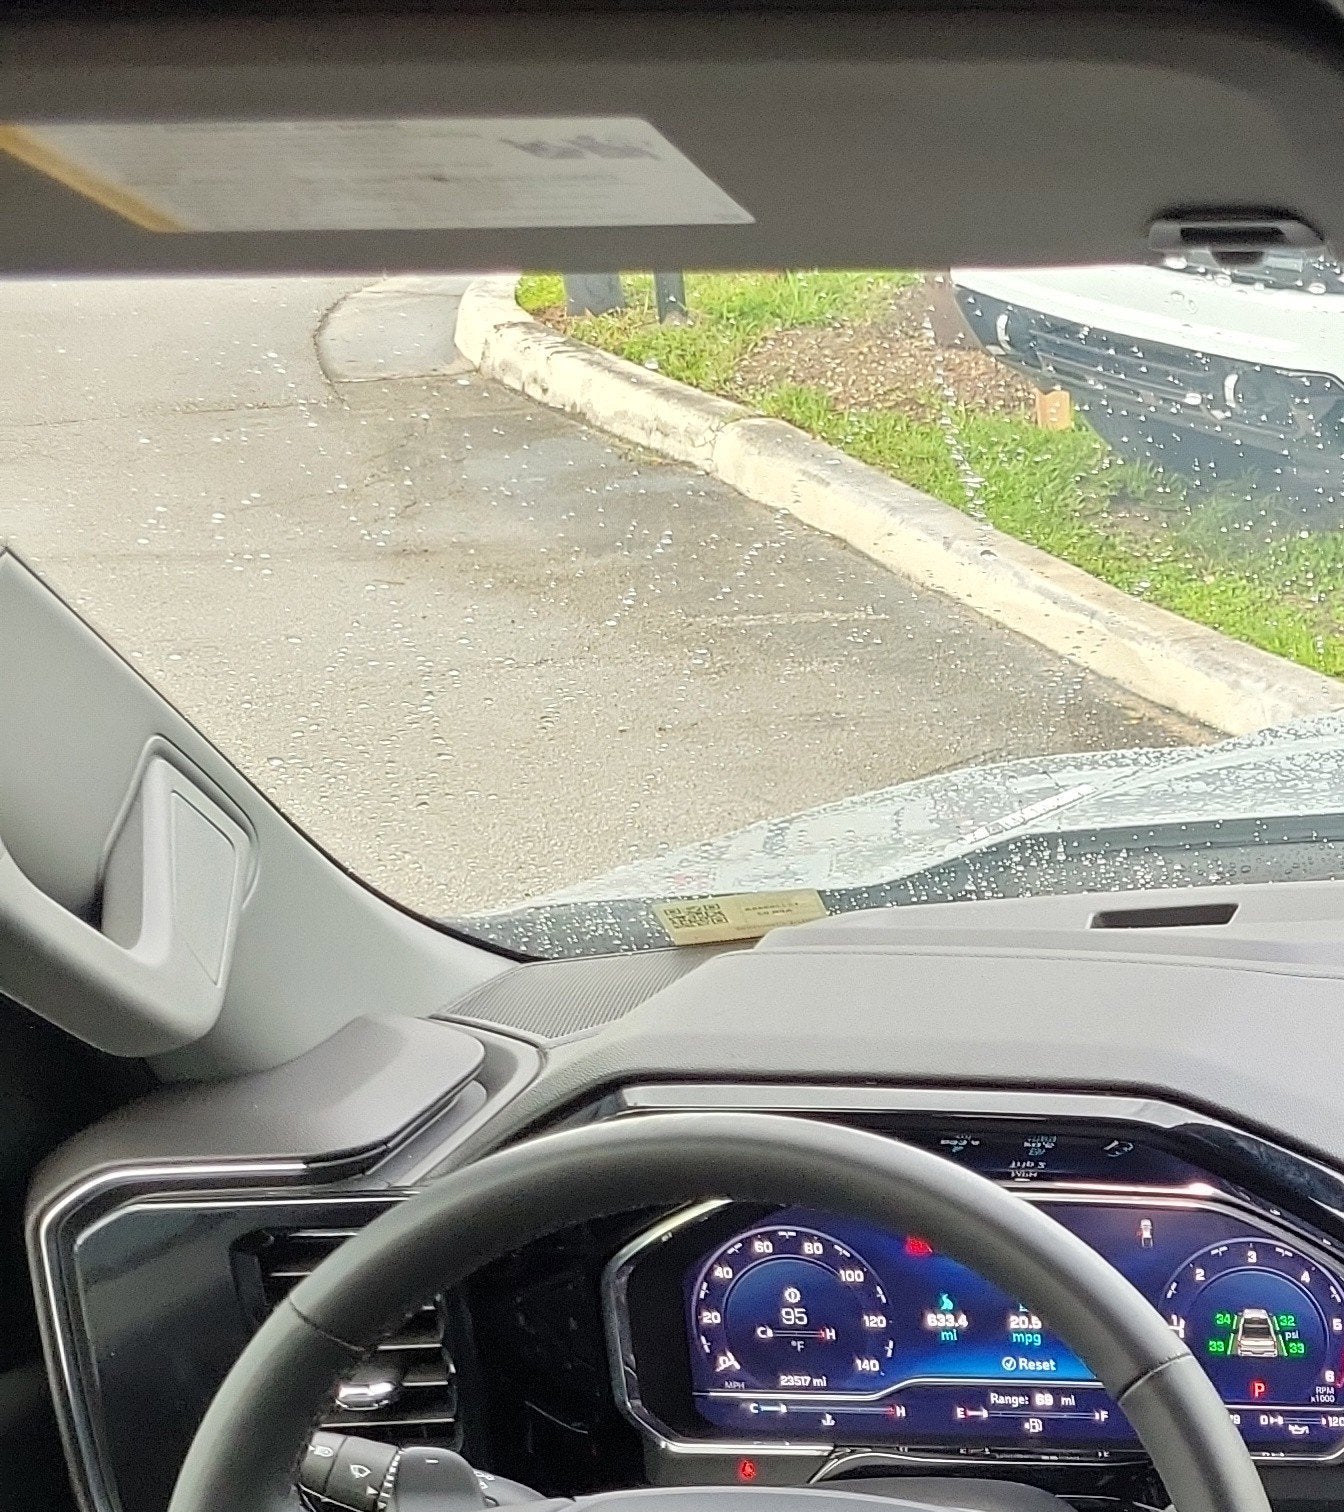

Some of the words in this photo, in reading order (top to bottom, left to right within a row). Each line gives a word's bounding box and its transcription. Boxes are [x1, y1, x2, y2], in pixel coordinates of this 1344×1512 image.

[754, 1240, 774, 1255] 60
[803, 1242, 824, 1256] 80
[1247, 1251, 1258, 1263] 3
[714, 1266, 733, 1280] 40
[839, 1269, 865, 1283] 100
[1195, 1268, 1206, 1281] 2
[1300, 1270, 1311, 1283] 4
[702, 1311, 722, 1324] 20
[780, 1307, 808, 1325] 95
[863, 1314, 887, 1328] 120
[926, 1313, 969, 1328] 633.4
[1215, 1312, 1232, 1326] 34
[1279, 1315, 1296, 1328] 32
[756, 1326, 768, 1339] C
[826, 1328, 836, 1341] H
[941, 1329, 958, 1341] mi
[1012, 1332, 1042, 1346] mpg
[1285, 1331, 1299, 1341] psi
[790, 1340, 805, 1352] °F
[1208, 1341, 1225, 1353] 33
[1288, 1342, 1305, 1354] 33
[855, 1358, 880, 1372] 140
[1018, 1357, 1057, 1371] Reset
[724, 1380, 745, 1389] MPH
[780, 1374, 811, 1387] 23517
[812, 1376, 827, 1387] mi
[1254, 1381, 1265, 1397] P
[1315, 1385, 1335, 1395] RPM
[990, 1392, 1030, 1408] Range:
[1060, 1395, 1076, 1406] mi
[1310, 1394, 1335, 1403] x1000
[750, 1402, 759, 1414] C
[896, 1405, 906, 1417] H
[956, 1407, 966, 1419] E
[1100, 1410, 1109, 1422] F
